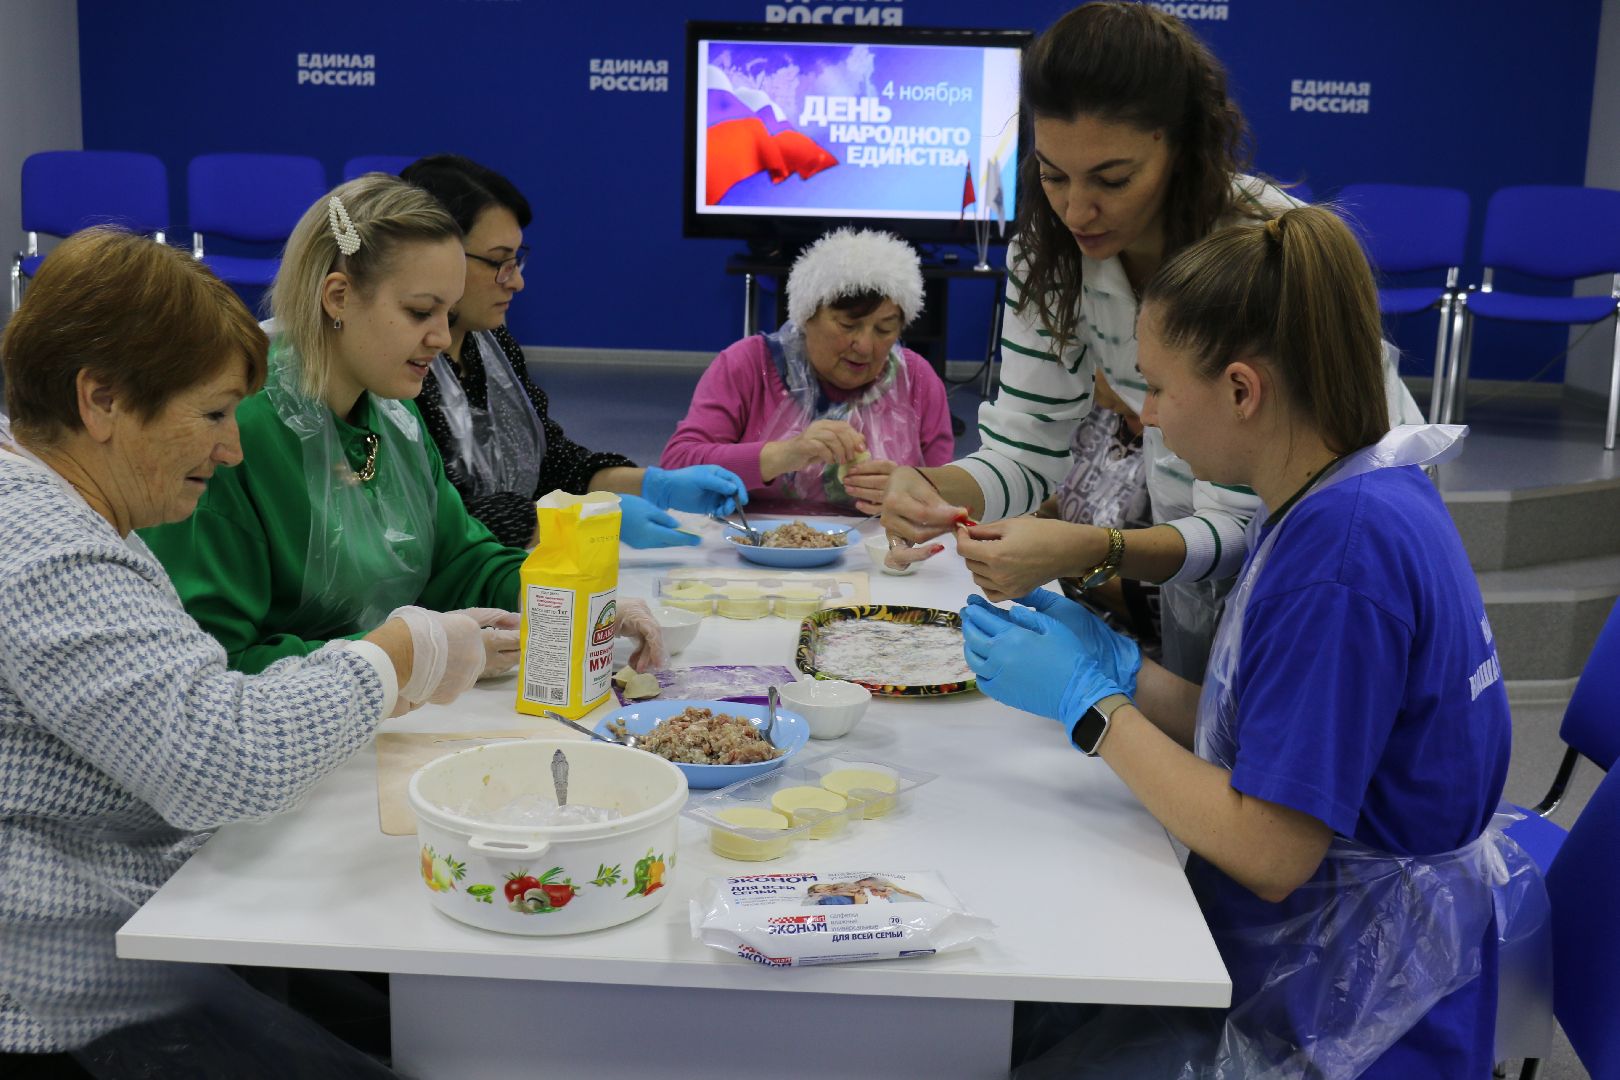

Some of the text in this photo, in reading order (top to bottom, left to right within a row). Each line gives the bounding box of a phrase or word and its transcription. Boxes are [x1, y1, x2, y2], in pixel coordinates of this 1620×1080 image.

[766, 5, 903, 26] РОССИЯ
[298, 53, 375, 70] ЕДИНАЯ
[589, 58, 668, 75] ЕДИНАЯ
[298, 70, 375, 86] РОССИЯ
[590, 75, 668, 92] РОССИЯ
[882, 80, 973, 105] 4 ноября
[1291, 79, 1370, 96] ЕДИНАЯ
[799, 95, 892, 127] ДЕНЬ
[1290, 96, 1369, 113] РОССИЯ
[829, 124, 971, 147] НАРОДНОГО
[847, 145, 969, 167] ЕДИНСТВА
[768, 923, 828, 935] ЭКОНОМ
[832, 931, 903, 942] ДЛЯ ВСЕЙ СЕМЬИ
